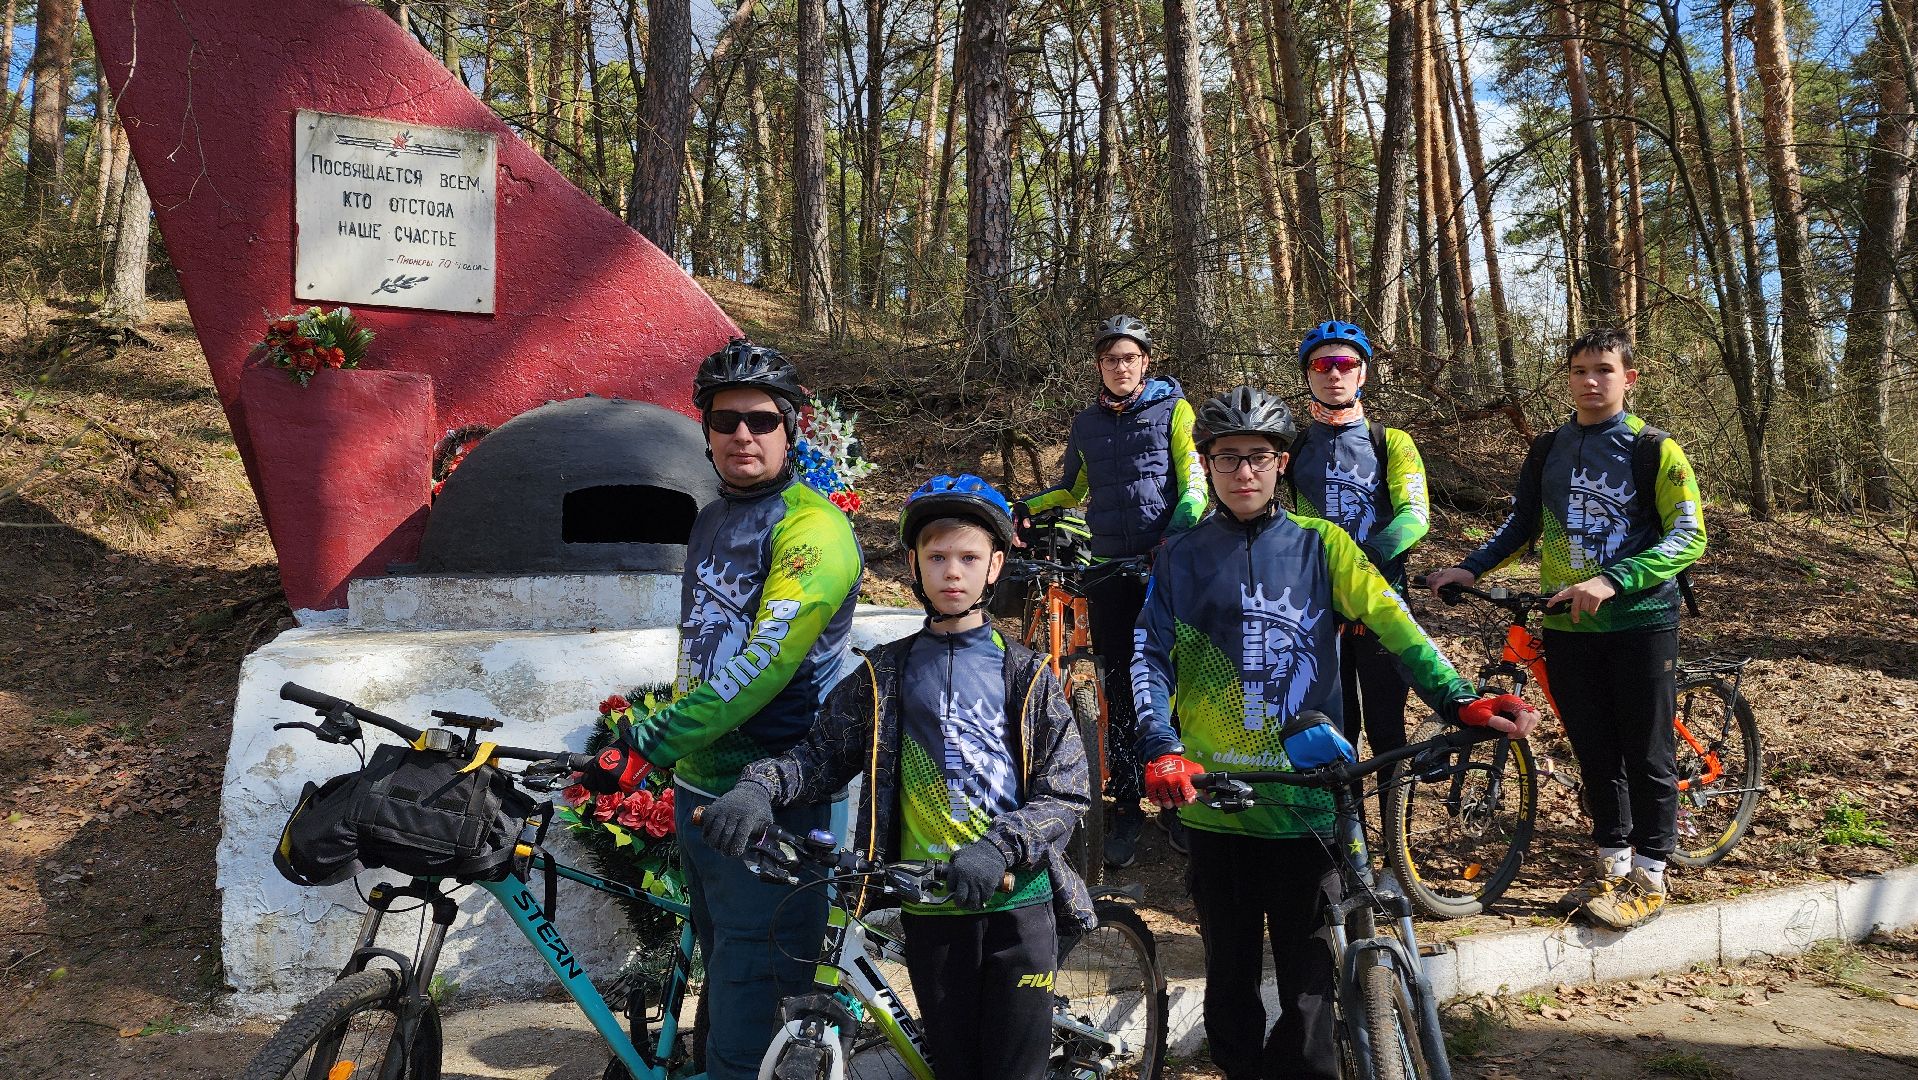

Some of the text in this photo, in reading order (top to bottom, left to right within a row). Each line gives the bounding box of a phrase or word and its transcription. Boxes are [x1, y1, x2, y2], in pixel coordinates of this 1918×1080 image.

[342, 191, 454, 218] КТО ОТСТОЯЛ
[338, 220, 457, 247] НАШЕ СЧАСТЬЕ
[1567, 493, 1584, 569] BIKE KING
[708, 599, 801, 704] РОССИЯ
[1242, 620, 1264, 731] BIKE KING
[1212, 747, 1291, 768] adventur
[512, 889, 584, 980] STERN
[1016, 970, 1053, 988] FILA
